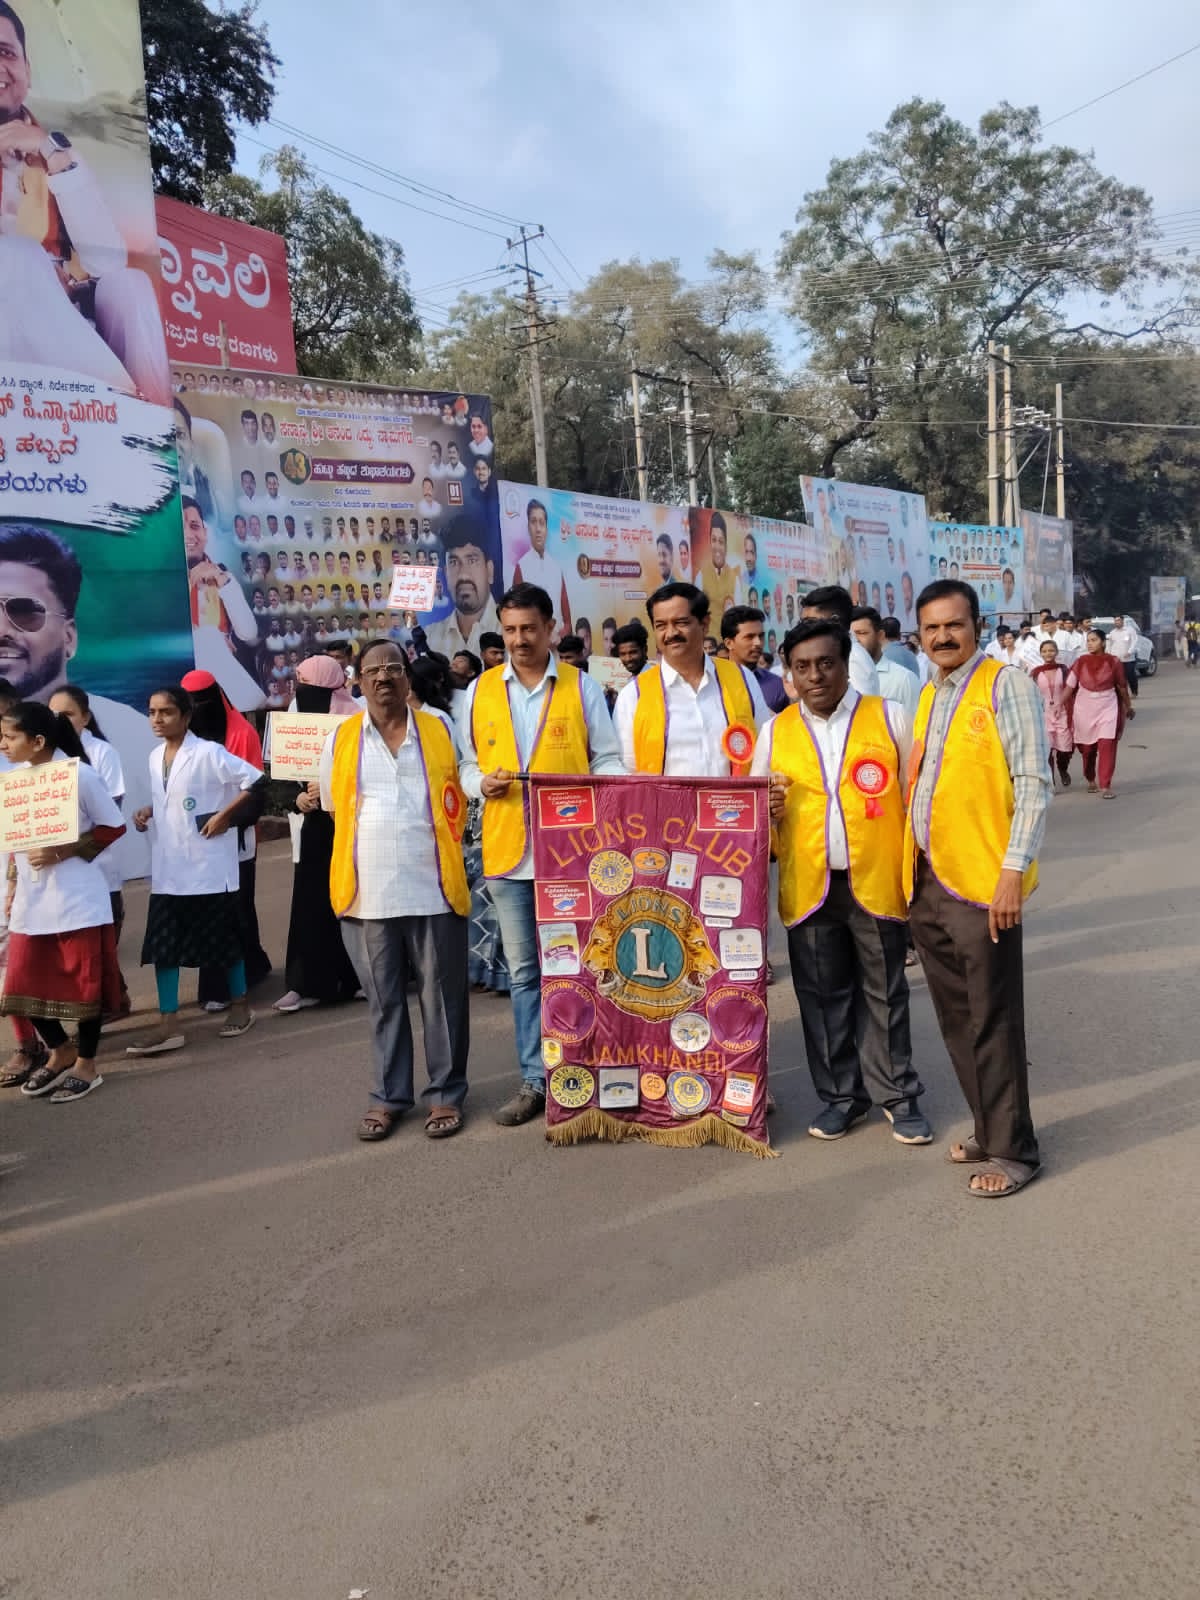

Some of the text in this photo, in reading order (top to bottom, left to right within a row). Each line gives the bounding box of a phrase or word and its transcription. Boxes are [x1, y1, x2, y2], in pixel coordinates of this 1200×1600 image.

[16, 432, 78, 464] ಹಬ್ಬದ
[314, 463, 334, 480] ಹುಟ್ಟು
[337, 464, 357, 481] ಹಬ್ಬದ
[547, 813, 753, 876] LIONS CLUB
[616, 896, 682, 926] LIONS
[630, 927, 668, 979] L
[584, 1043, 726, 1073] JAMKHANDI
[552, 1086, 592, 1106] SPONSOR
